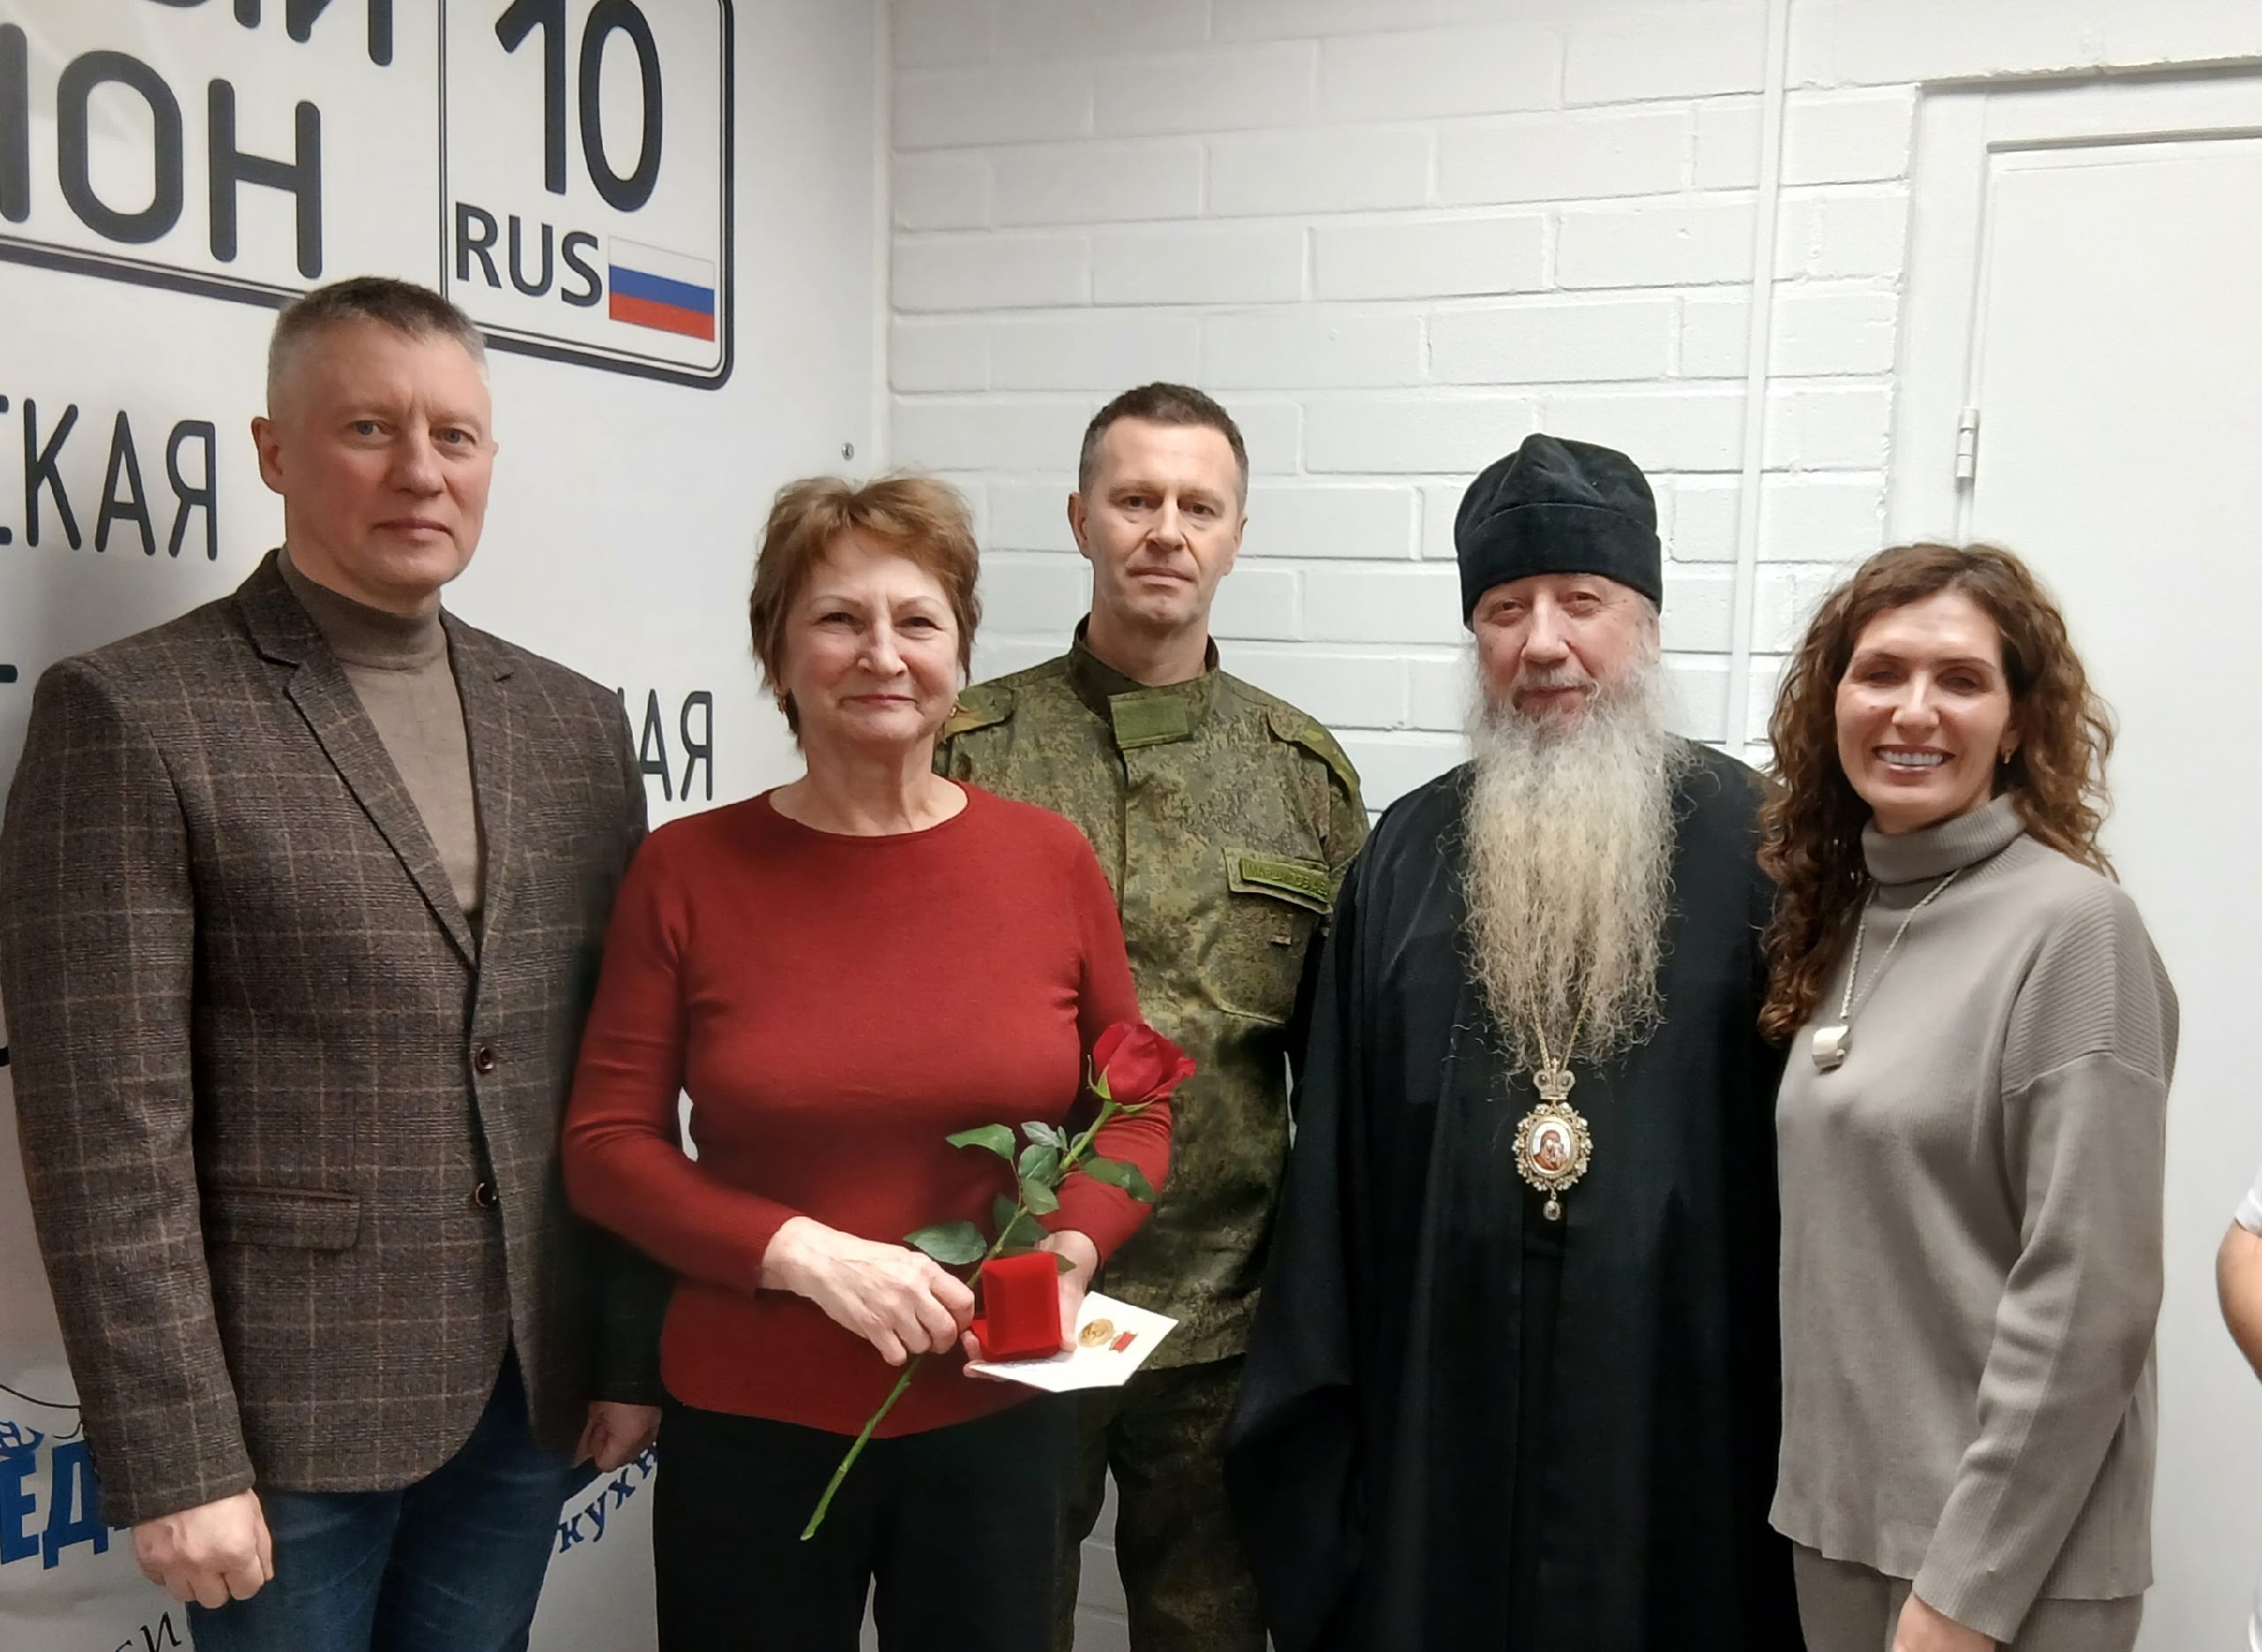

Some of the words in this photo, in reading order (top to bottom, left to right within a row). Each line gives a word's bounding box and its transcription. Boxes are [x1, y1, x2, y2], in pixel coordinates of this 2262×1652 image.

[495, 0, 663, 213] 10
[455, 201, 603, 307] RUS
[0, 395, 218, 562] КАЯ
[618, 686, 713, 802] АЯ
[0, 1439, 130, 1571] ЕД
